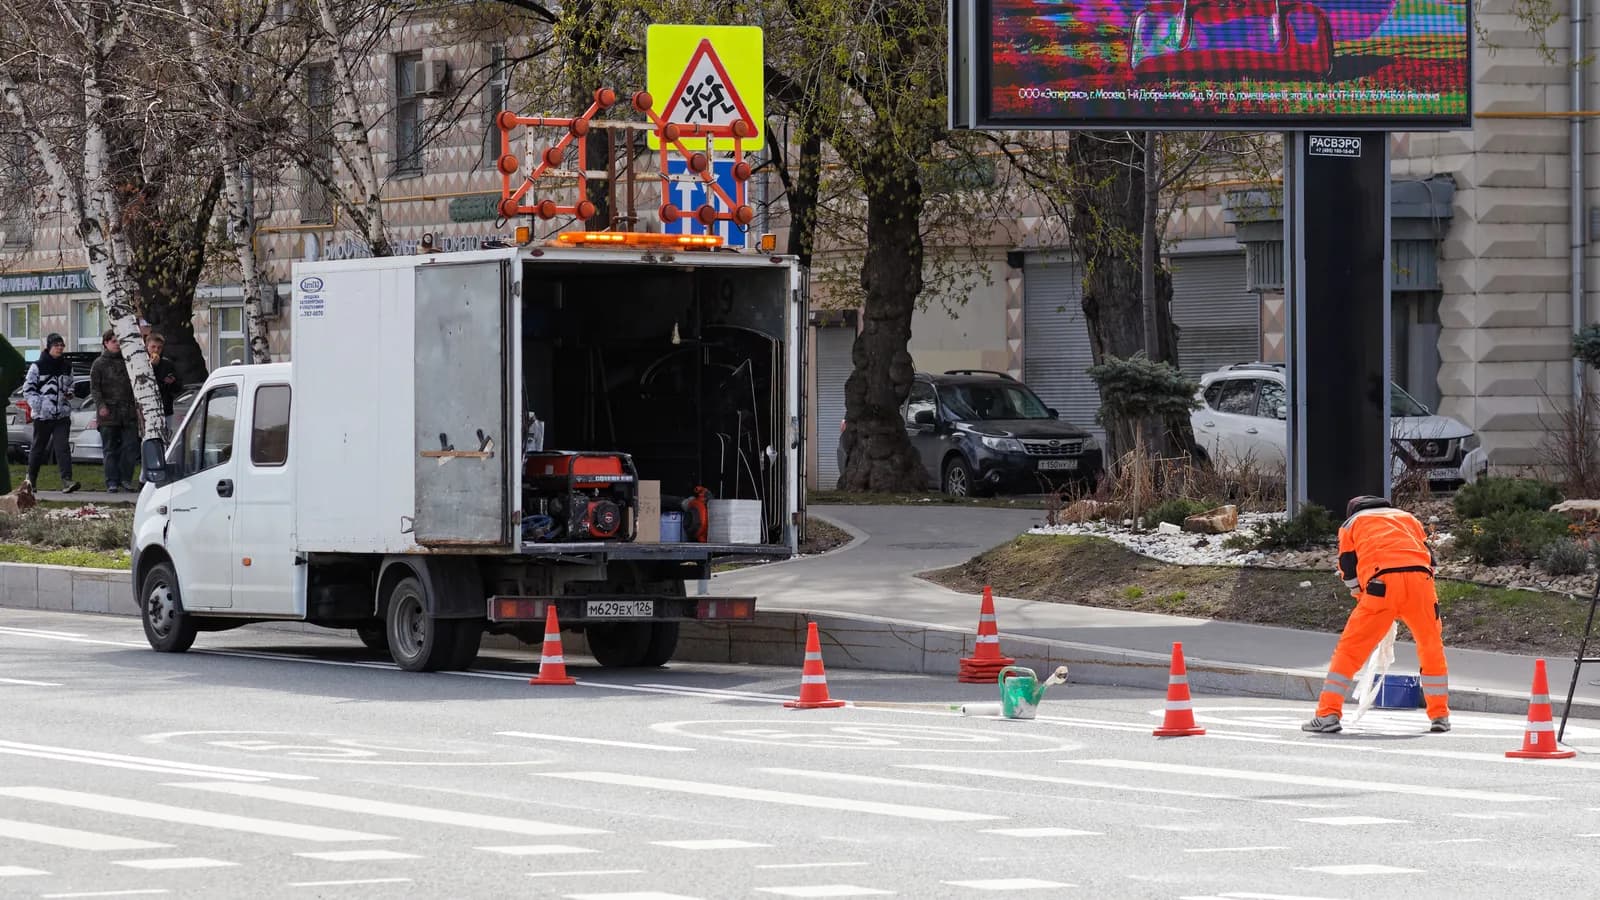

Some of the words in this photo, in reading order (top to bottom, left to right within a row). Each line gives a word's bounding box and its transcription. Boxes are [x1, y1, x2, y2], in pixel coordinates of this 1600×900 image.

[1018, 88, 1040, 99] ООО
[1311, 137, 1360, 149] РАСВЭРО
[590, 602, 632, 616] М629ЕХ
[634, 602, 650, 612] 126
